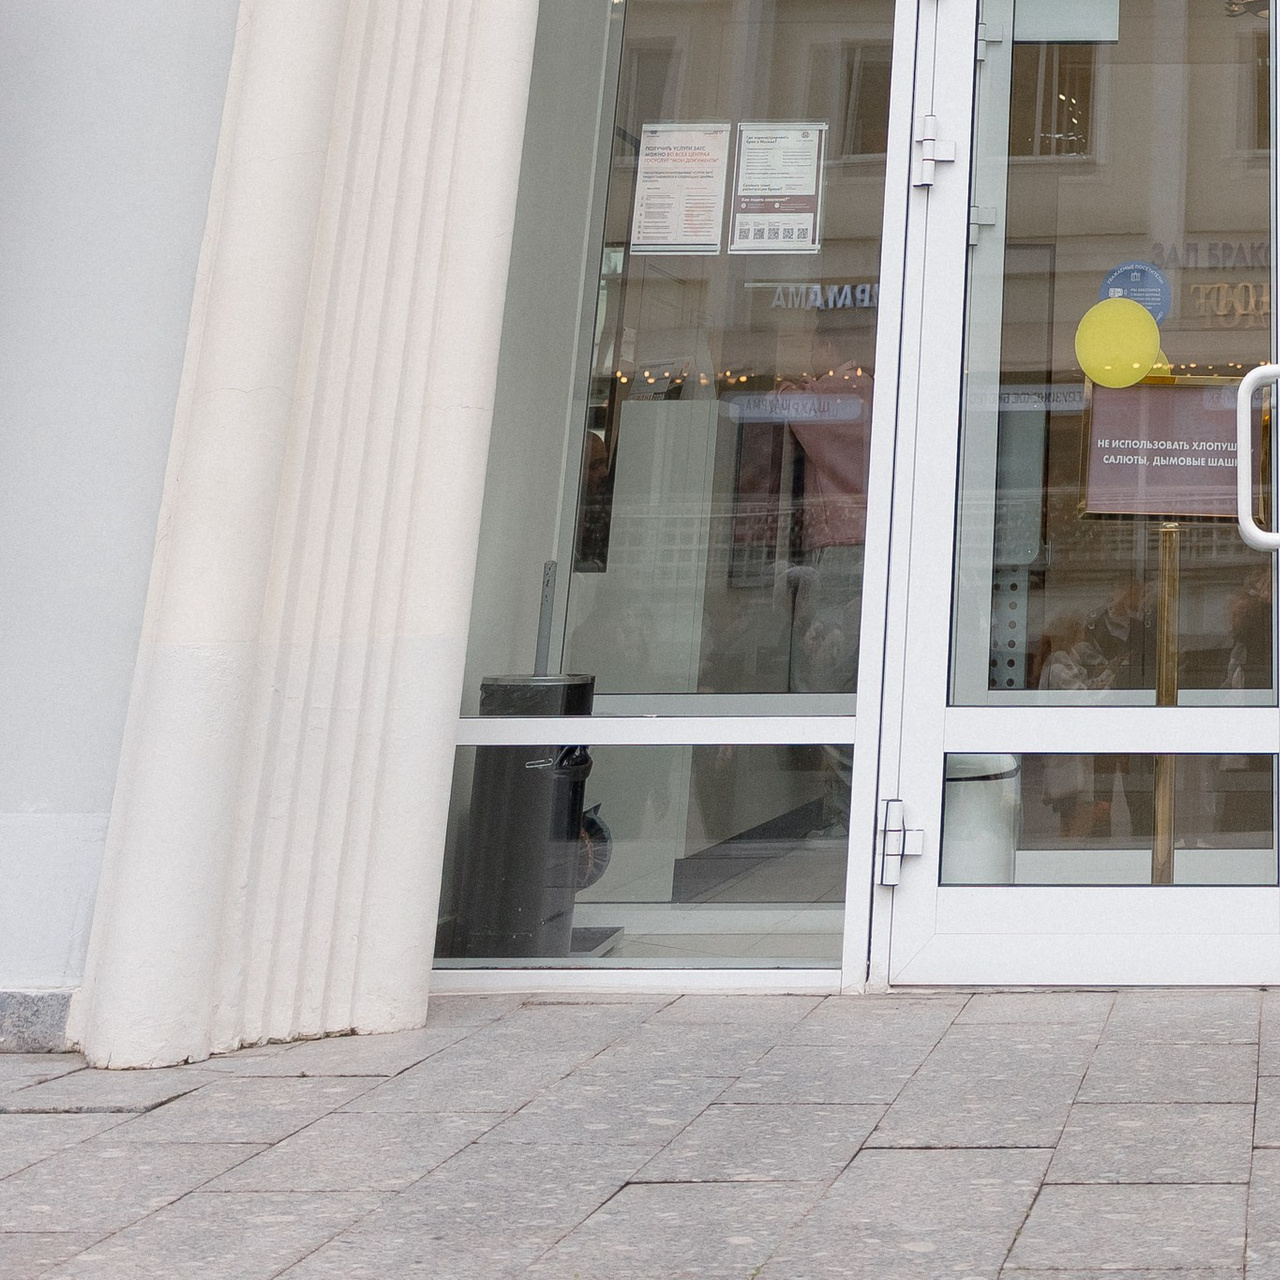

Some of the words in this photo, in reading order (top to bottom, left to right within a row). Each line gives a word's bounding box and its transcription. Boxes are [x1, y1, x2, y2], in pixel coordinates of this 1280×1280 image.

[1098, 439, 1110, 448] НЕ
[1112, 439, 1189, 450] ИСПОЛЬЗОВАТЬ
[1103, 454, 1150, 466] САЛЮТЫ,
[1152, 456, 1206, 467] ДЫМОВЫЕ
